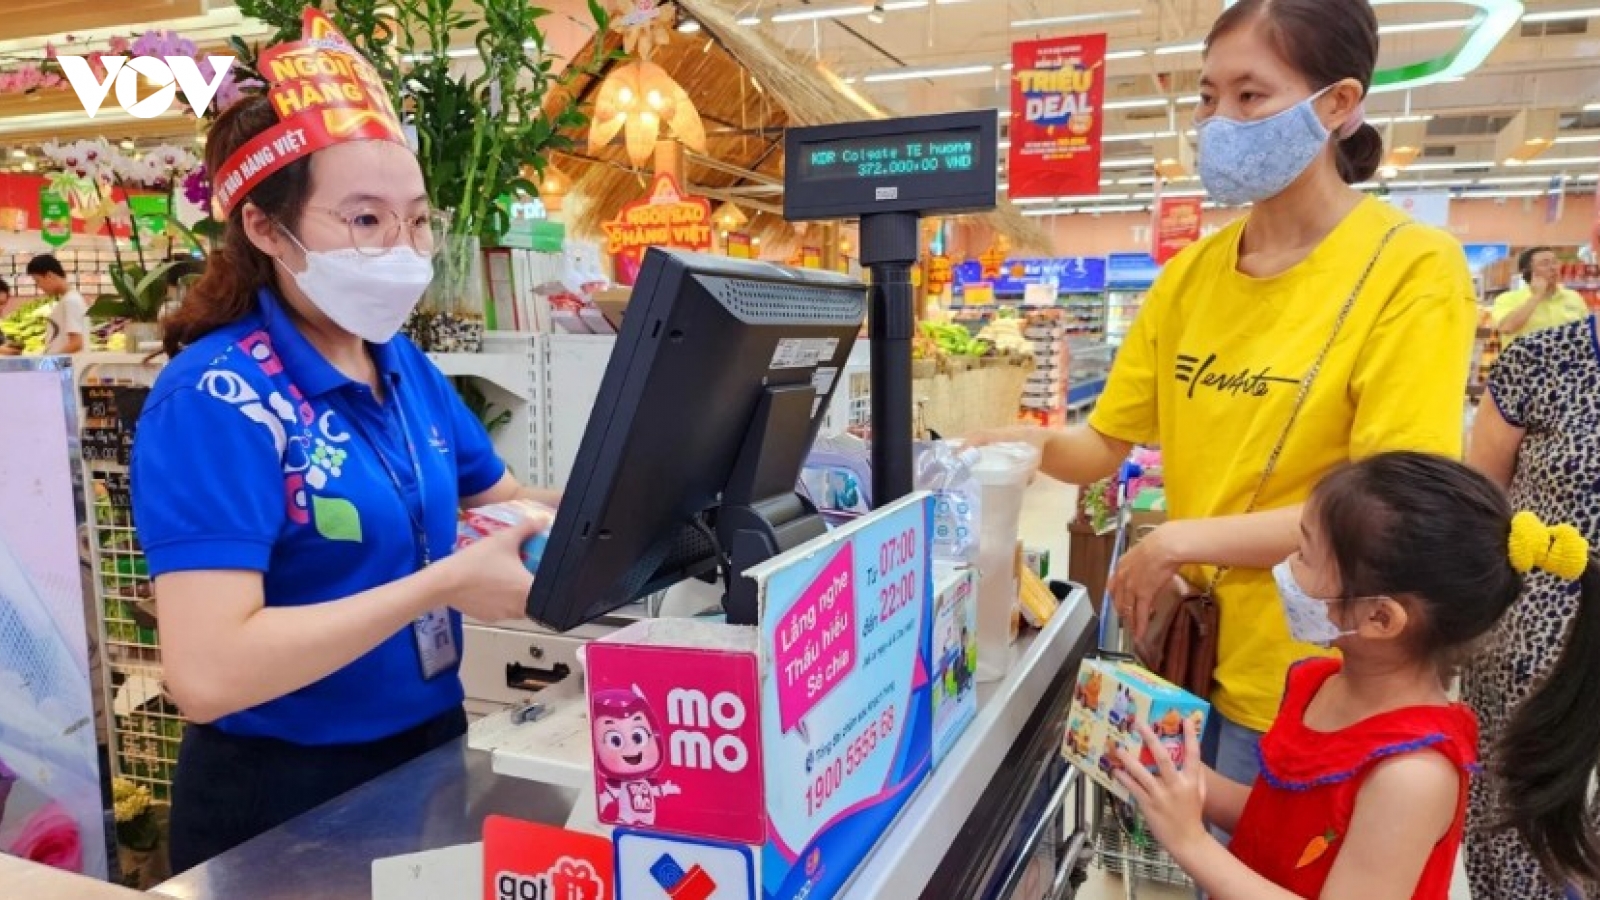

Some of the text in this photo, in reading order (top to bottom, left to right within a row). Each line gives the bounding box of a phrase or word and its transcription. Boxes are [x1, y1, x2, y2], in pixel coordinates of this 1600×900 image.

[1025, 92, 1095, 121] DEAL
[880, 526, 915, 577] 07:00
[819, 571, 848, 612] nghe
[880, 569, 915, 622] 22:00
[825, 650, 849, 681] chia
[806, 757, 842, 817] 1900
